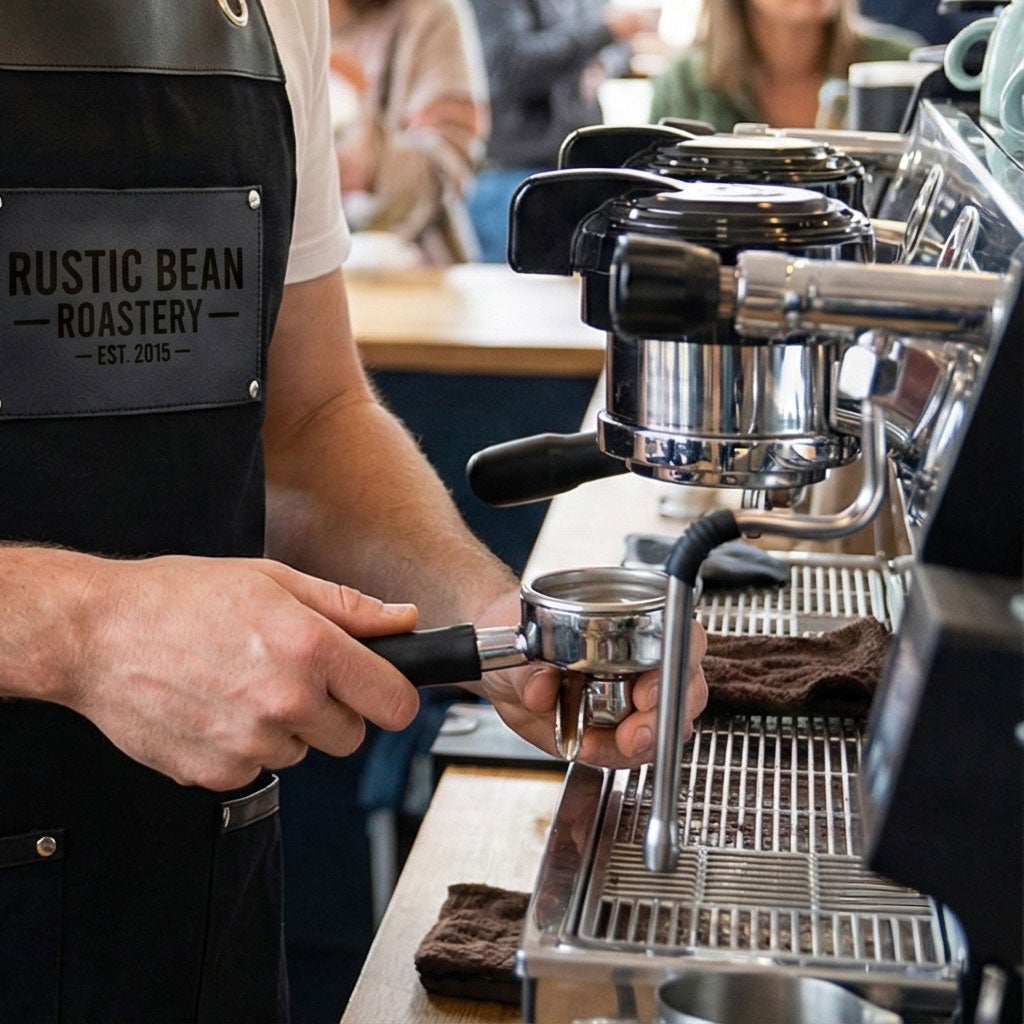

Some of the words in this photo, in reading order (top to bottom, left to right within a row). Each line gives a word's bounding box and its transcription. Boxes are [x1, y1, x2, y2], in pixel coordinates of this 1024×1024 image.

[9, 249, 142, 296] RUSTIC
[156, 247, 243, 291] BEAN
[58, 298, 203, 338] ROASTERY
[97, 345, 130, 365] EST.
[134, 342, 171, 364] 2015
